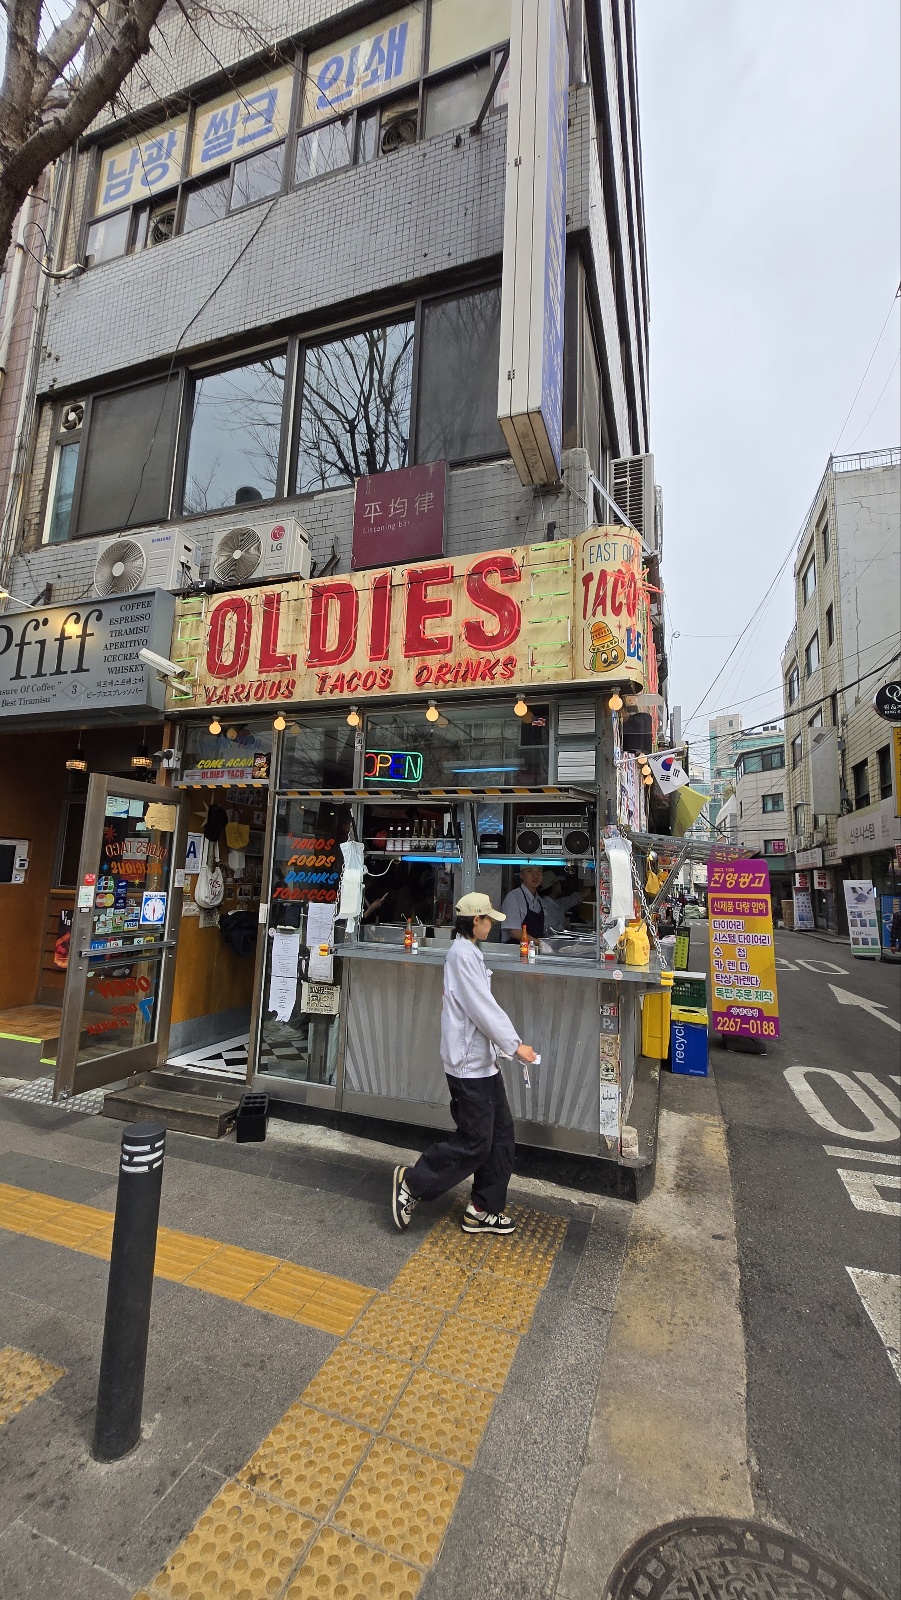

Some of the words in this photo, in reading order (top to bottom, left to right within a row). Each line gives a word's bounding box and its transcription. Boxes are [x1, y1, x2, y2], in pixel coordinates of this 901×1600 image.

[102, 129, 178, 206] 남광
[200, 88, 279, 164] 씰크
[316, 20, 409, 111] 인쇄
[362, 491, 435, 524] 平均律
[362, 523, 396, 534] Listening
[270, 542, 283, 552] LG
[589, 542, 618, 565] EAST
[120, 600, 153, 612] COFFEE
[109, 613, 151, 626] ESPRESSO
[205, 551, 523, 679] OLDIES
[109, 625, 150, 639] TIRAMISU
[102, 638, 148, 652] APERITIVO
[103, 651, 141, 664] ICECREA
[107, 664, 146, 676] WHISKEY
[414, 655, 517, 688] DRINKS
[314, 665, 394, 695] TACOS
[20, 683, 31, 694] Of
[32, 681, 56, 693] Coffee
[71, 684, 78, 695] 3
[203, 678, 297, 706] VARIOUS
[1, 697, 17, 708] Best
[18, 695, 51, 706] Tiramisu
[196, 759, 226, 769] COME
[365, 753, 421, 779] OPEN
[201, 770, 225, 779] OLDIES
[227, 769, 245, 778] TACO
[185, 840, 198, 859] A
[291, 838, 336, 851] TACOS
[287, 855, 336, 868] FOODS
[284, 870, 339, 885] DRINKS
[709, 872, 767, 889] 진영광고
[713, 900, 734, 913] 신제품
[735, 901, 751, 913] 다량
[751, 901, 767, 914] 입하
[712, 919, 745, 930] 다이어리
[737, 933, 771, 945] 다이어리
[715, 973, 733, 985] 탁상
[733, 975, 760, 987] 카렌다
[735, 988, 753, 1000] 주문
[754, 990, 773, 1003] 제작
[716, 1016, 776, 1036] 2267-0188
[672, 1020, 688, 1064] recycle
